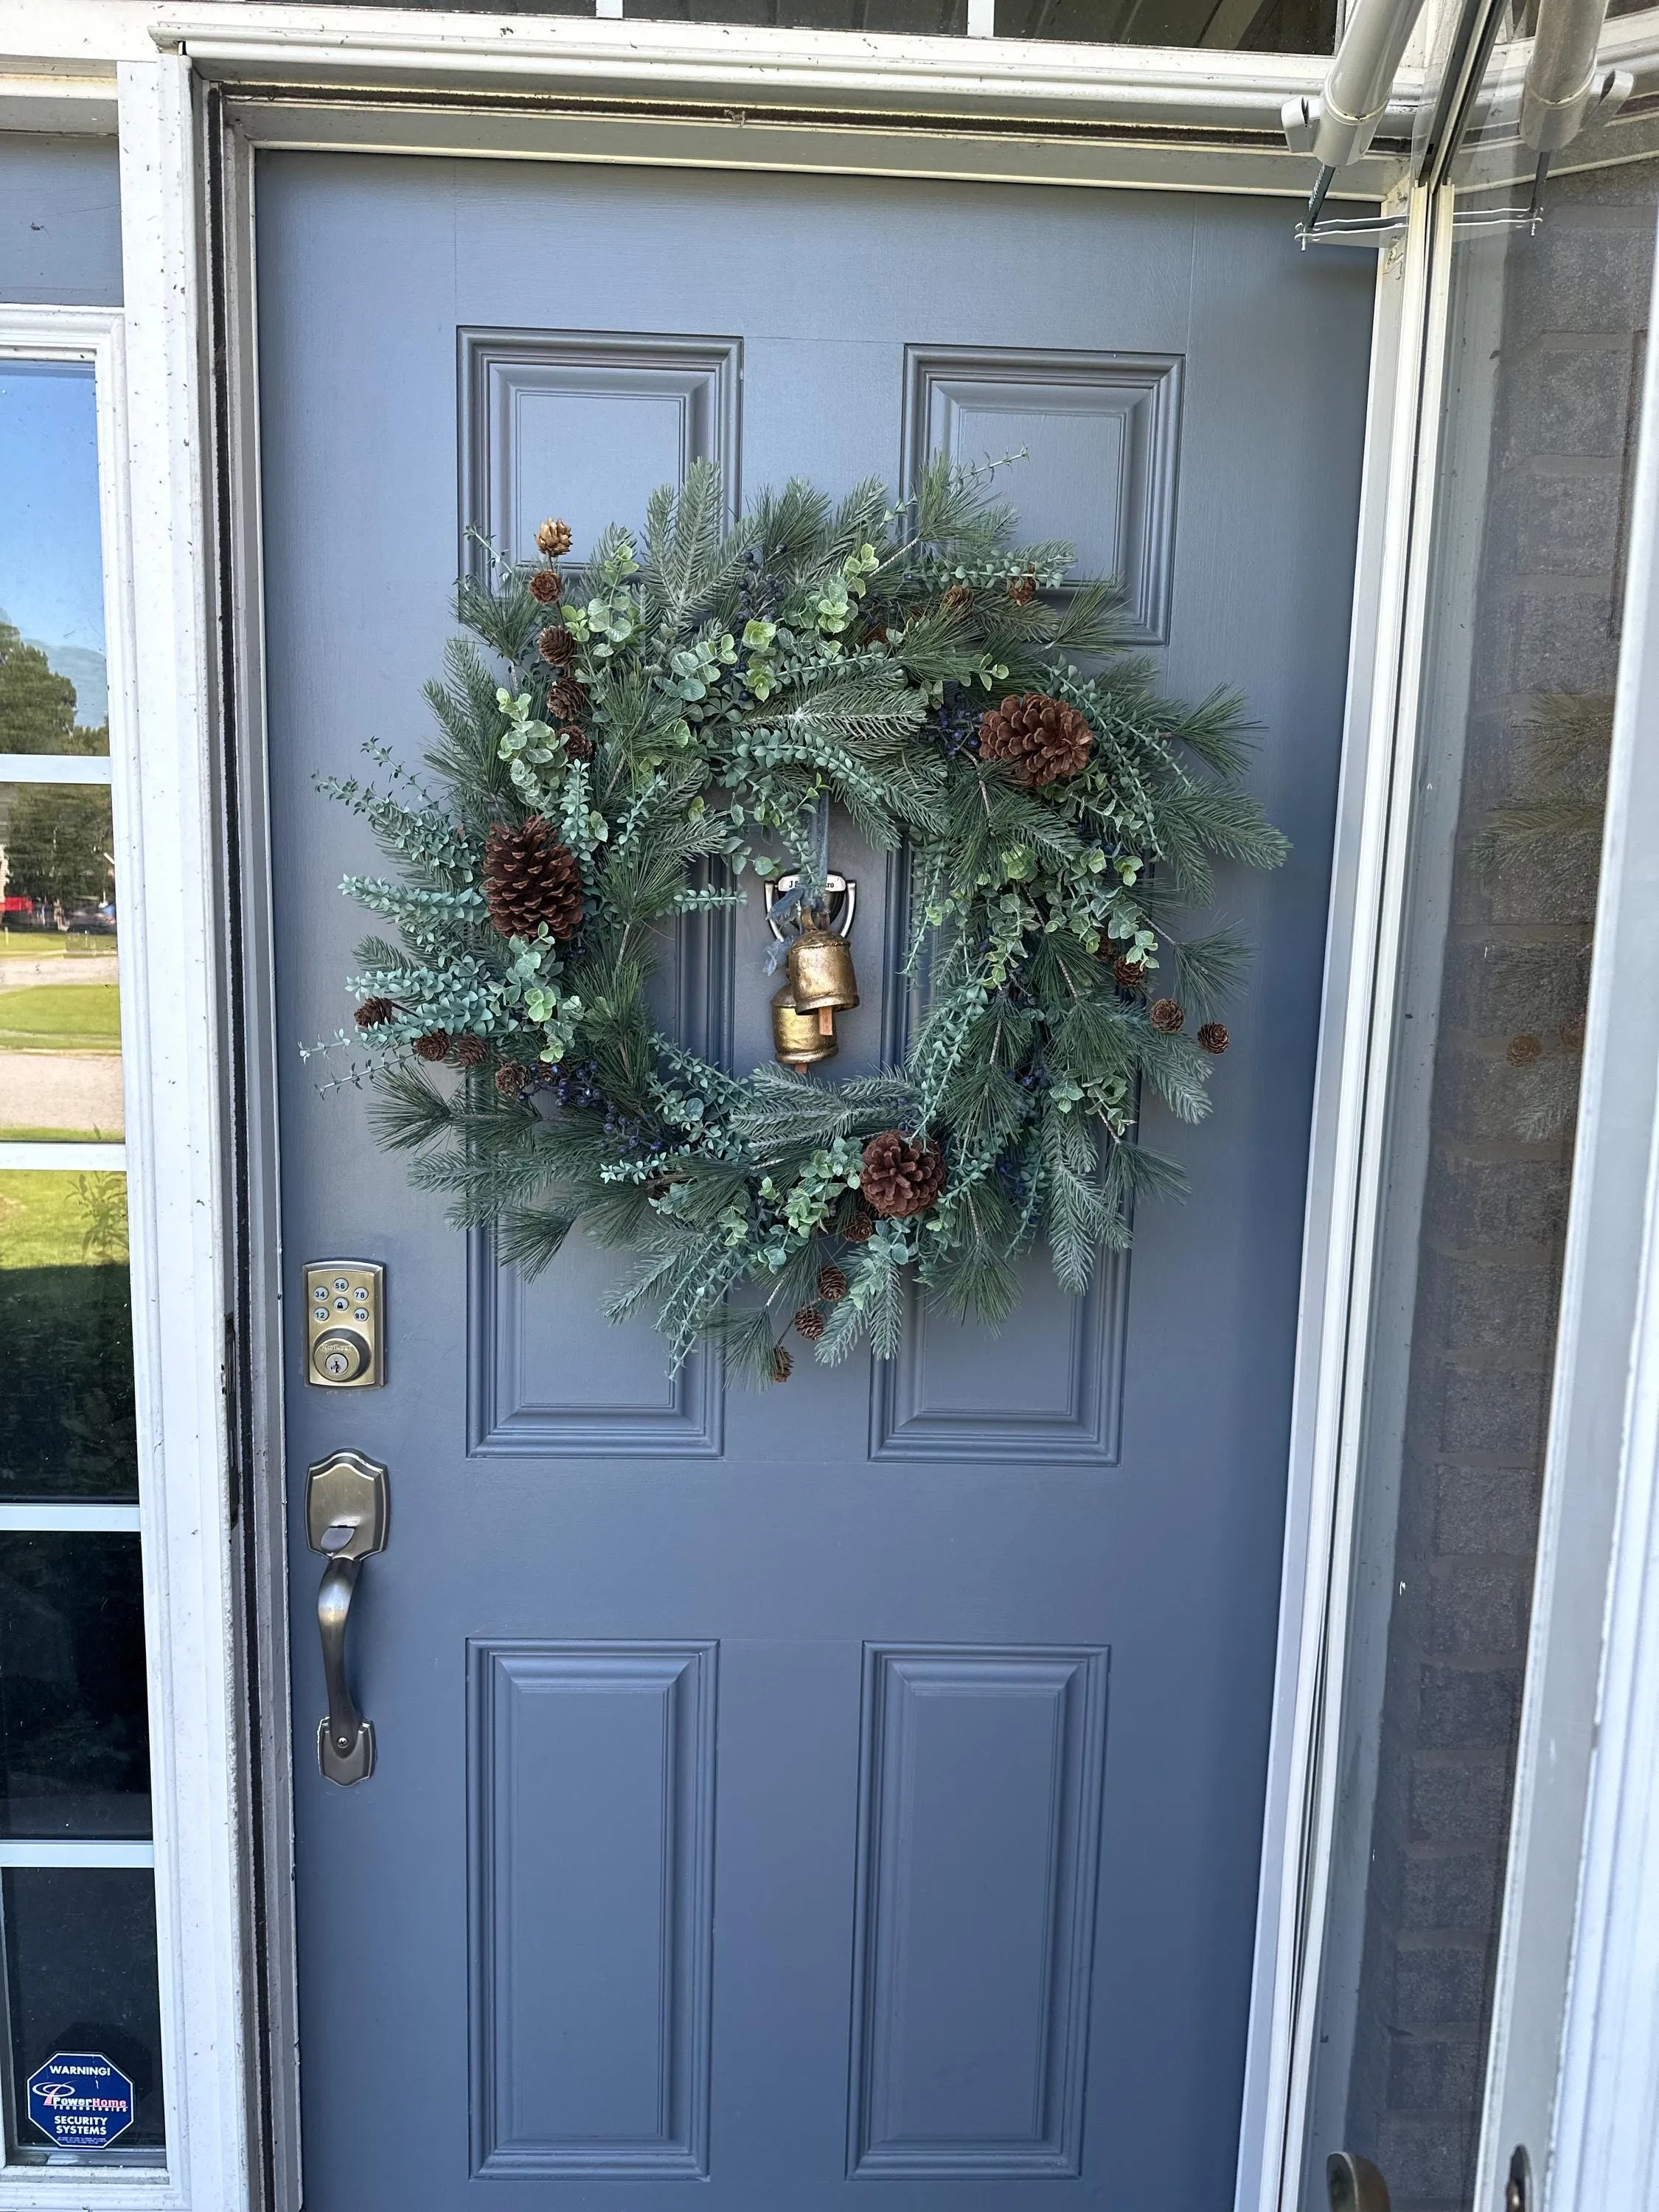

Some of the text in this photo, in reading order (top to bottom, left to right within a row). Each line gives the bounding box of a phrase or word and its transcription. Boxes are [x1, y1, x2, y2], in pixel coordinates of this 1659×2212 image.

[49, 2065, 111, 2076] WARNING!
[53, 2097, 127, 2107] PowerHome
[54, 2115, 108, 2126] SECURITY
[56, 2125, 107, 2135] SYSTEMS
